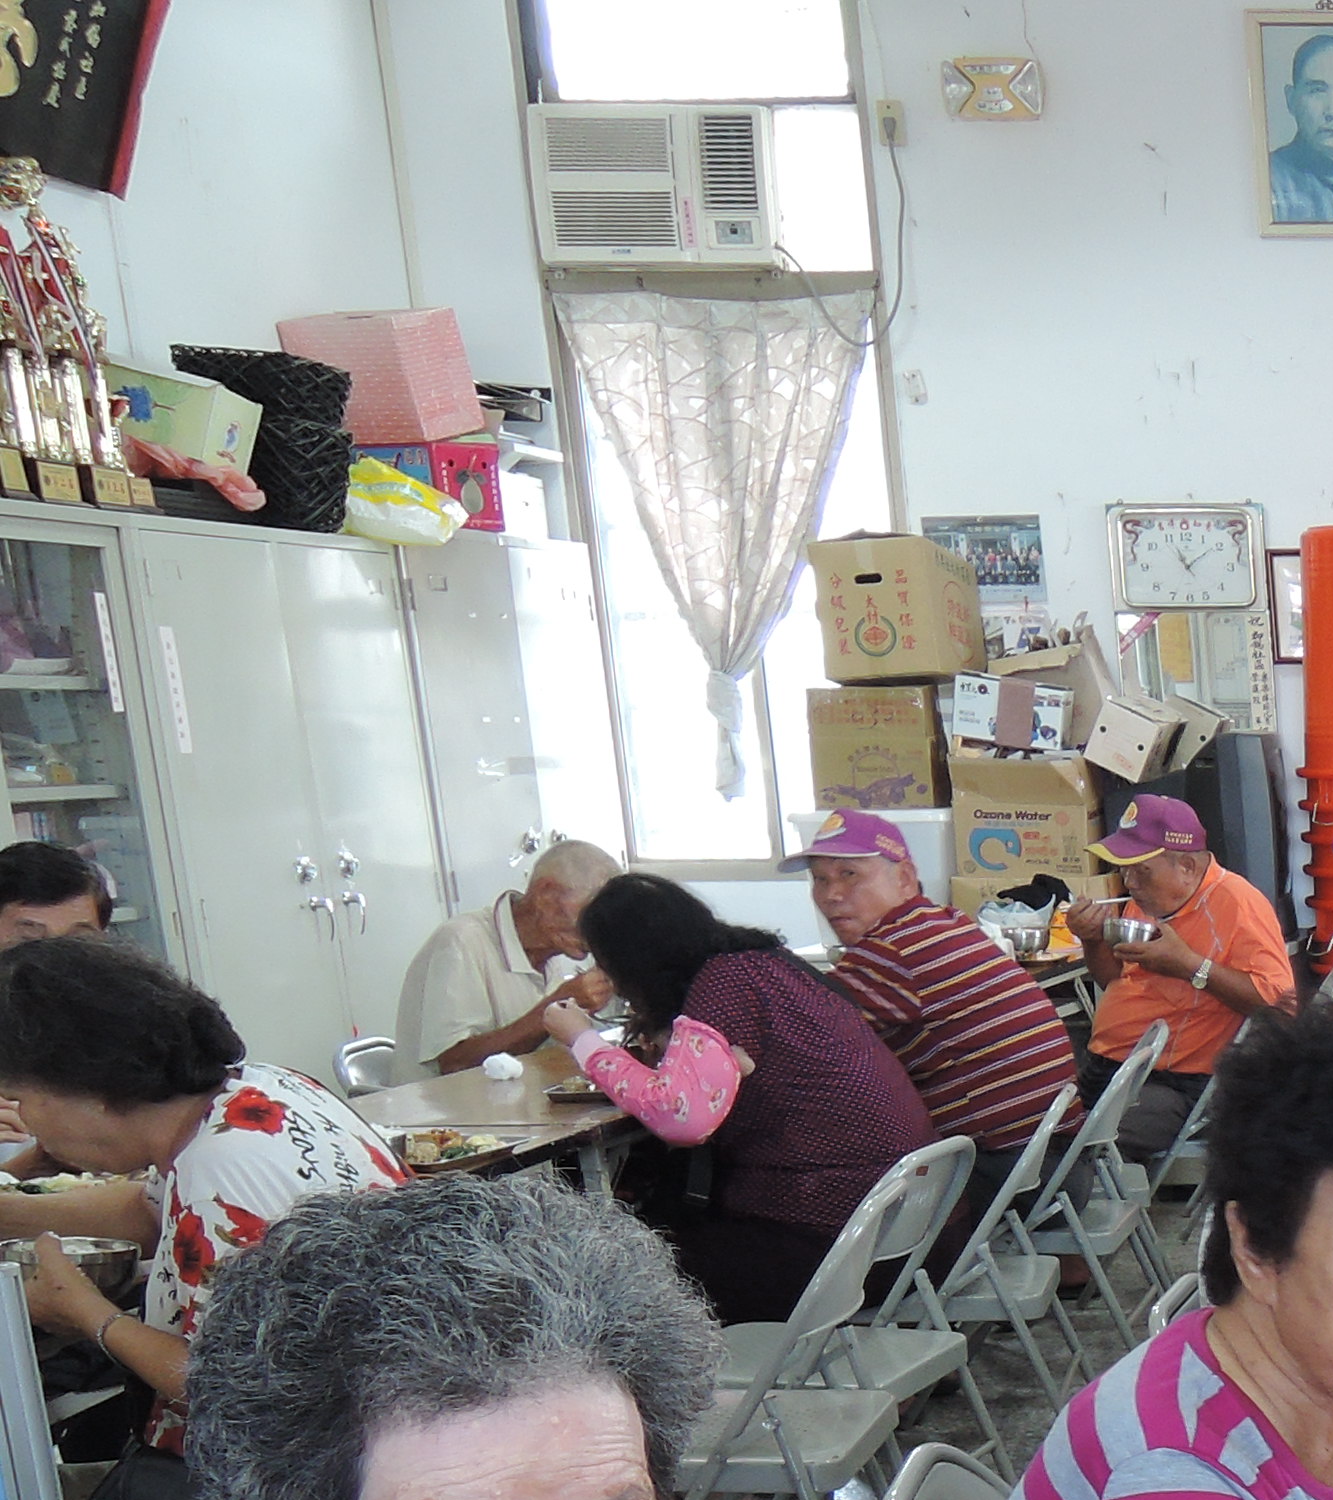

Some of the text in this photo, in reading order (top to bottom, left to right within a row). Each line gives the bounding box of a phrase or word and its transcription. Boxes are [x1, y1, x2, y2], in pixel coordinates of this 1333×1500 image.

[1164, 534, 1174, 544] 11
[1179, 532, 1192, 542] 12
[1200, 534, 1206, 545] 1
[1147, 542, 1158, 551] 10
[1215, 542, 1224, 551] 2
[1140, 562, 1149, 572] 9
[1226, 562, 1235, 572] 3
[1152, 582, 1161, 592] 8
[1216, 582, 1225, 592] 4
[1169, 591, 1178, 601] 7
[1185, 593, 1194, 603] 6
[1202, 591, 1210, 601] 5
[973, 809, 1052, 821] Ozone Water
